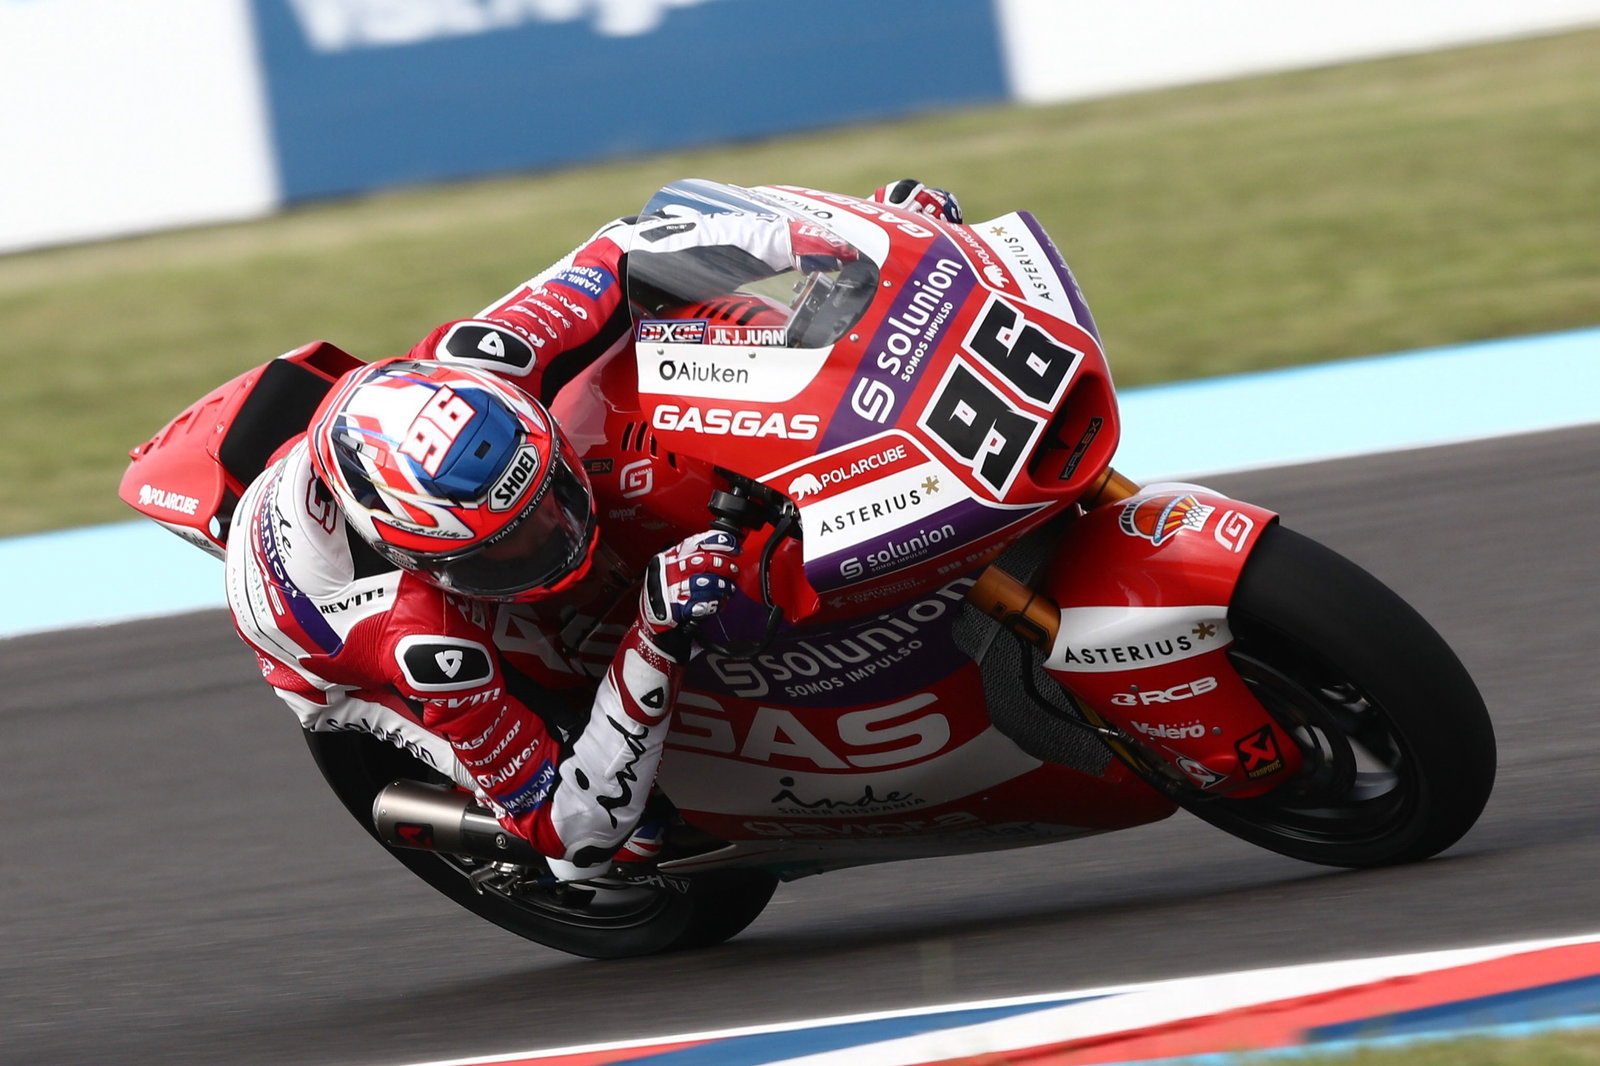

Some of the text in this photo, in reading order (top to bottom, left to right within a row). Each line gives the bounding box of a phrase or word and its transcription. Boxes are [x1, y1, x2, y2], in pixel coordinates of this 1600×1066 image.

[1004, 236, 1054, 302] ASTERIUS
[641, 322, 704, 342] DIXON
[876, 258, 963, 376] solunion
[901, 302, 954, 382] SOMOS IMPULSO
[920, 293, 1081, 498] 96
[397, 384, 478, 478] 96
[652, 404, 821, 441] GASGAS
[494, 451, 537, 507] SHOEI
[821, 444, 908, 488] POLARCUBE
[151, 487, 200, 516] POLARCUBE
[488, 520, 520, 546] TRADE
[520, 475, 552, 519] WATCHES
[549, 461, 559, 476] UK
[820, 489, 921, 537] ASTERIUS
[866, 523, 956, 568] solunion
[871, 560, 896, 573] SOMOS
[896, 549, 928, 566] IMPULSO
[320, 587, 385, 615] REV'IT!
[762, 577, 977, 682] solunion
[1064, 635, 1192, 665] ASTERIUS
[784, 639, 924, 699] SOMOS IMPULSO
[475, 720, 522, 767] DUNLOP
[1131, 720, 1206, 740] Valero
[502, 766, 555, 811] HAMILTON
[777, 797, 927, 816] SOLER HISPANIA
